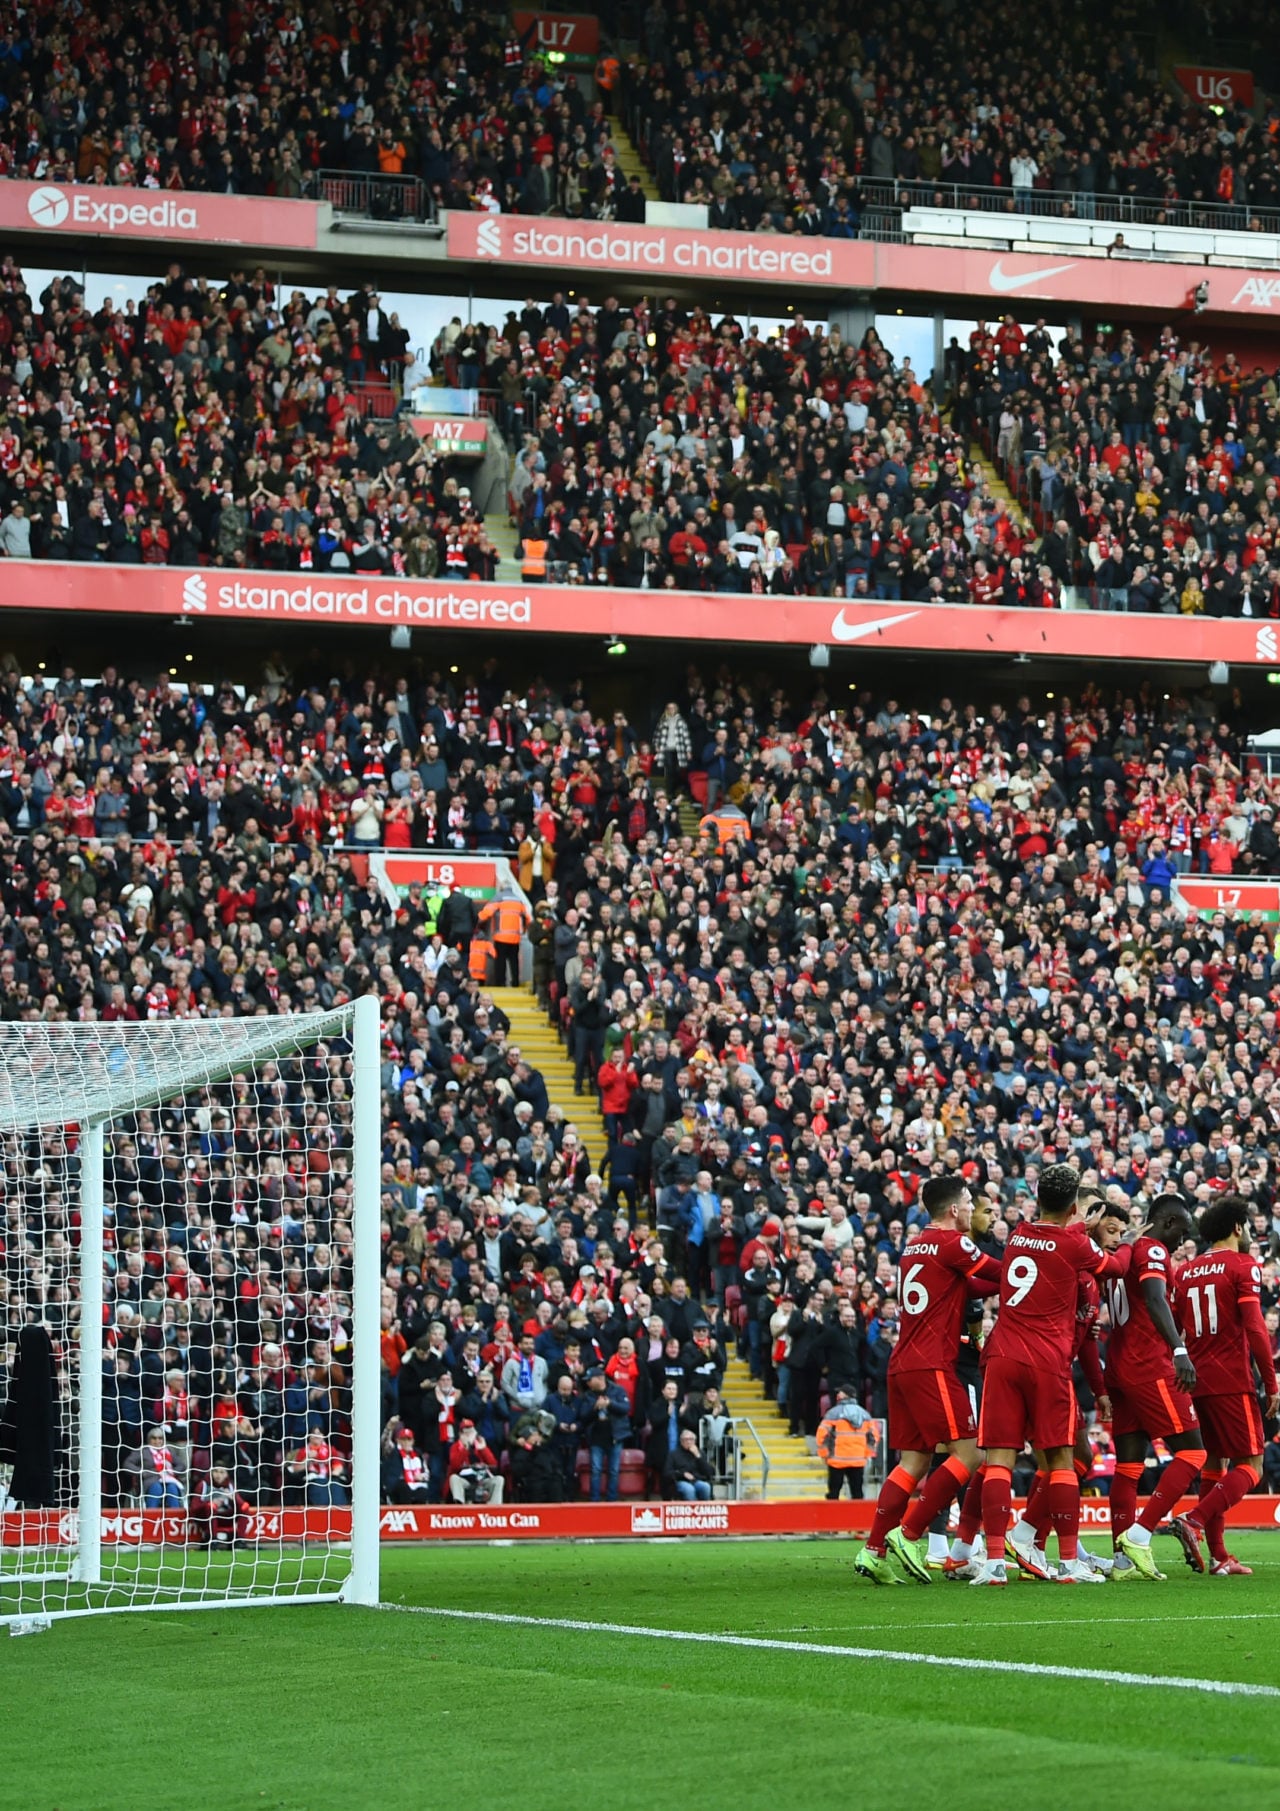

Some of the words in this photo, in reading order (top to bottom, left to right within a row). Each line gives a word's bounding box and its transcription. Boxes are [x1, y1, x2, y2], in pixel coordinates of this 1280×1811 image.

[537, 21, 576, 46] U7
[1196, 75, 1233, 99] U6
[73, 195, 197, 230] Expedia
[513, 227, 666, 264] standard
[674, 242, 832, 276] chartered
[432, 422, 465, 439] M7
[218, 581, 368, 616] standard
[374, 590, 531, 624] chartered
[427, 864, 455, 885] L8
[1217, 889, 1242, 909] L7
[1009, 1235, 1057, 1252] FIRMINO
[897, 1263, 929, 1315] 6
[1006, 1256, 1038, 1307] 9
[1106, 1278, 1130, 1329] 10
[1187, 1284, 1218, 1338] 11
[379, 1510, 419, 1532] AXA
[430, 1514, 475, 1528] Know
[478, 1514, 508, 1528] You
[509, 1513, 540, 1527] Can
[666, 1505, 728, 1515] PETRO-CANADA
[101, 1516, 143, 1538] MG
[666, 1516, 728, 1530] LUBRICANTS
